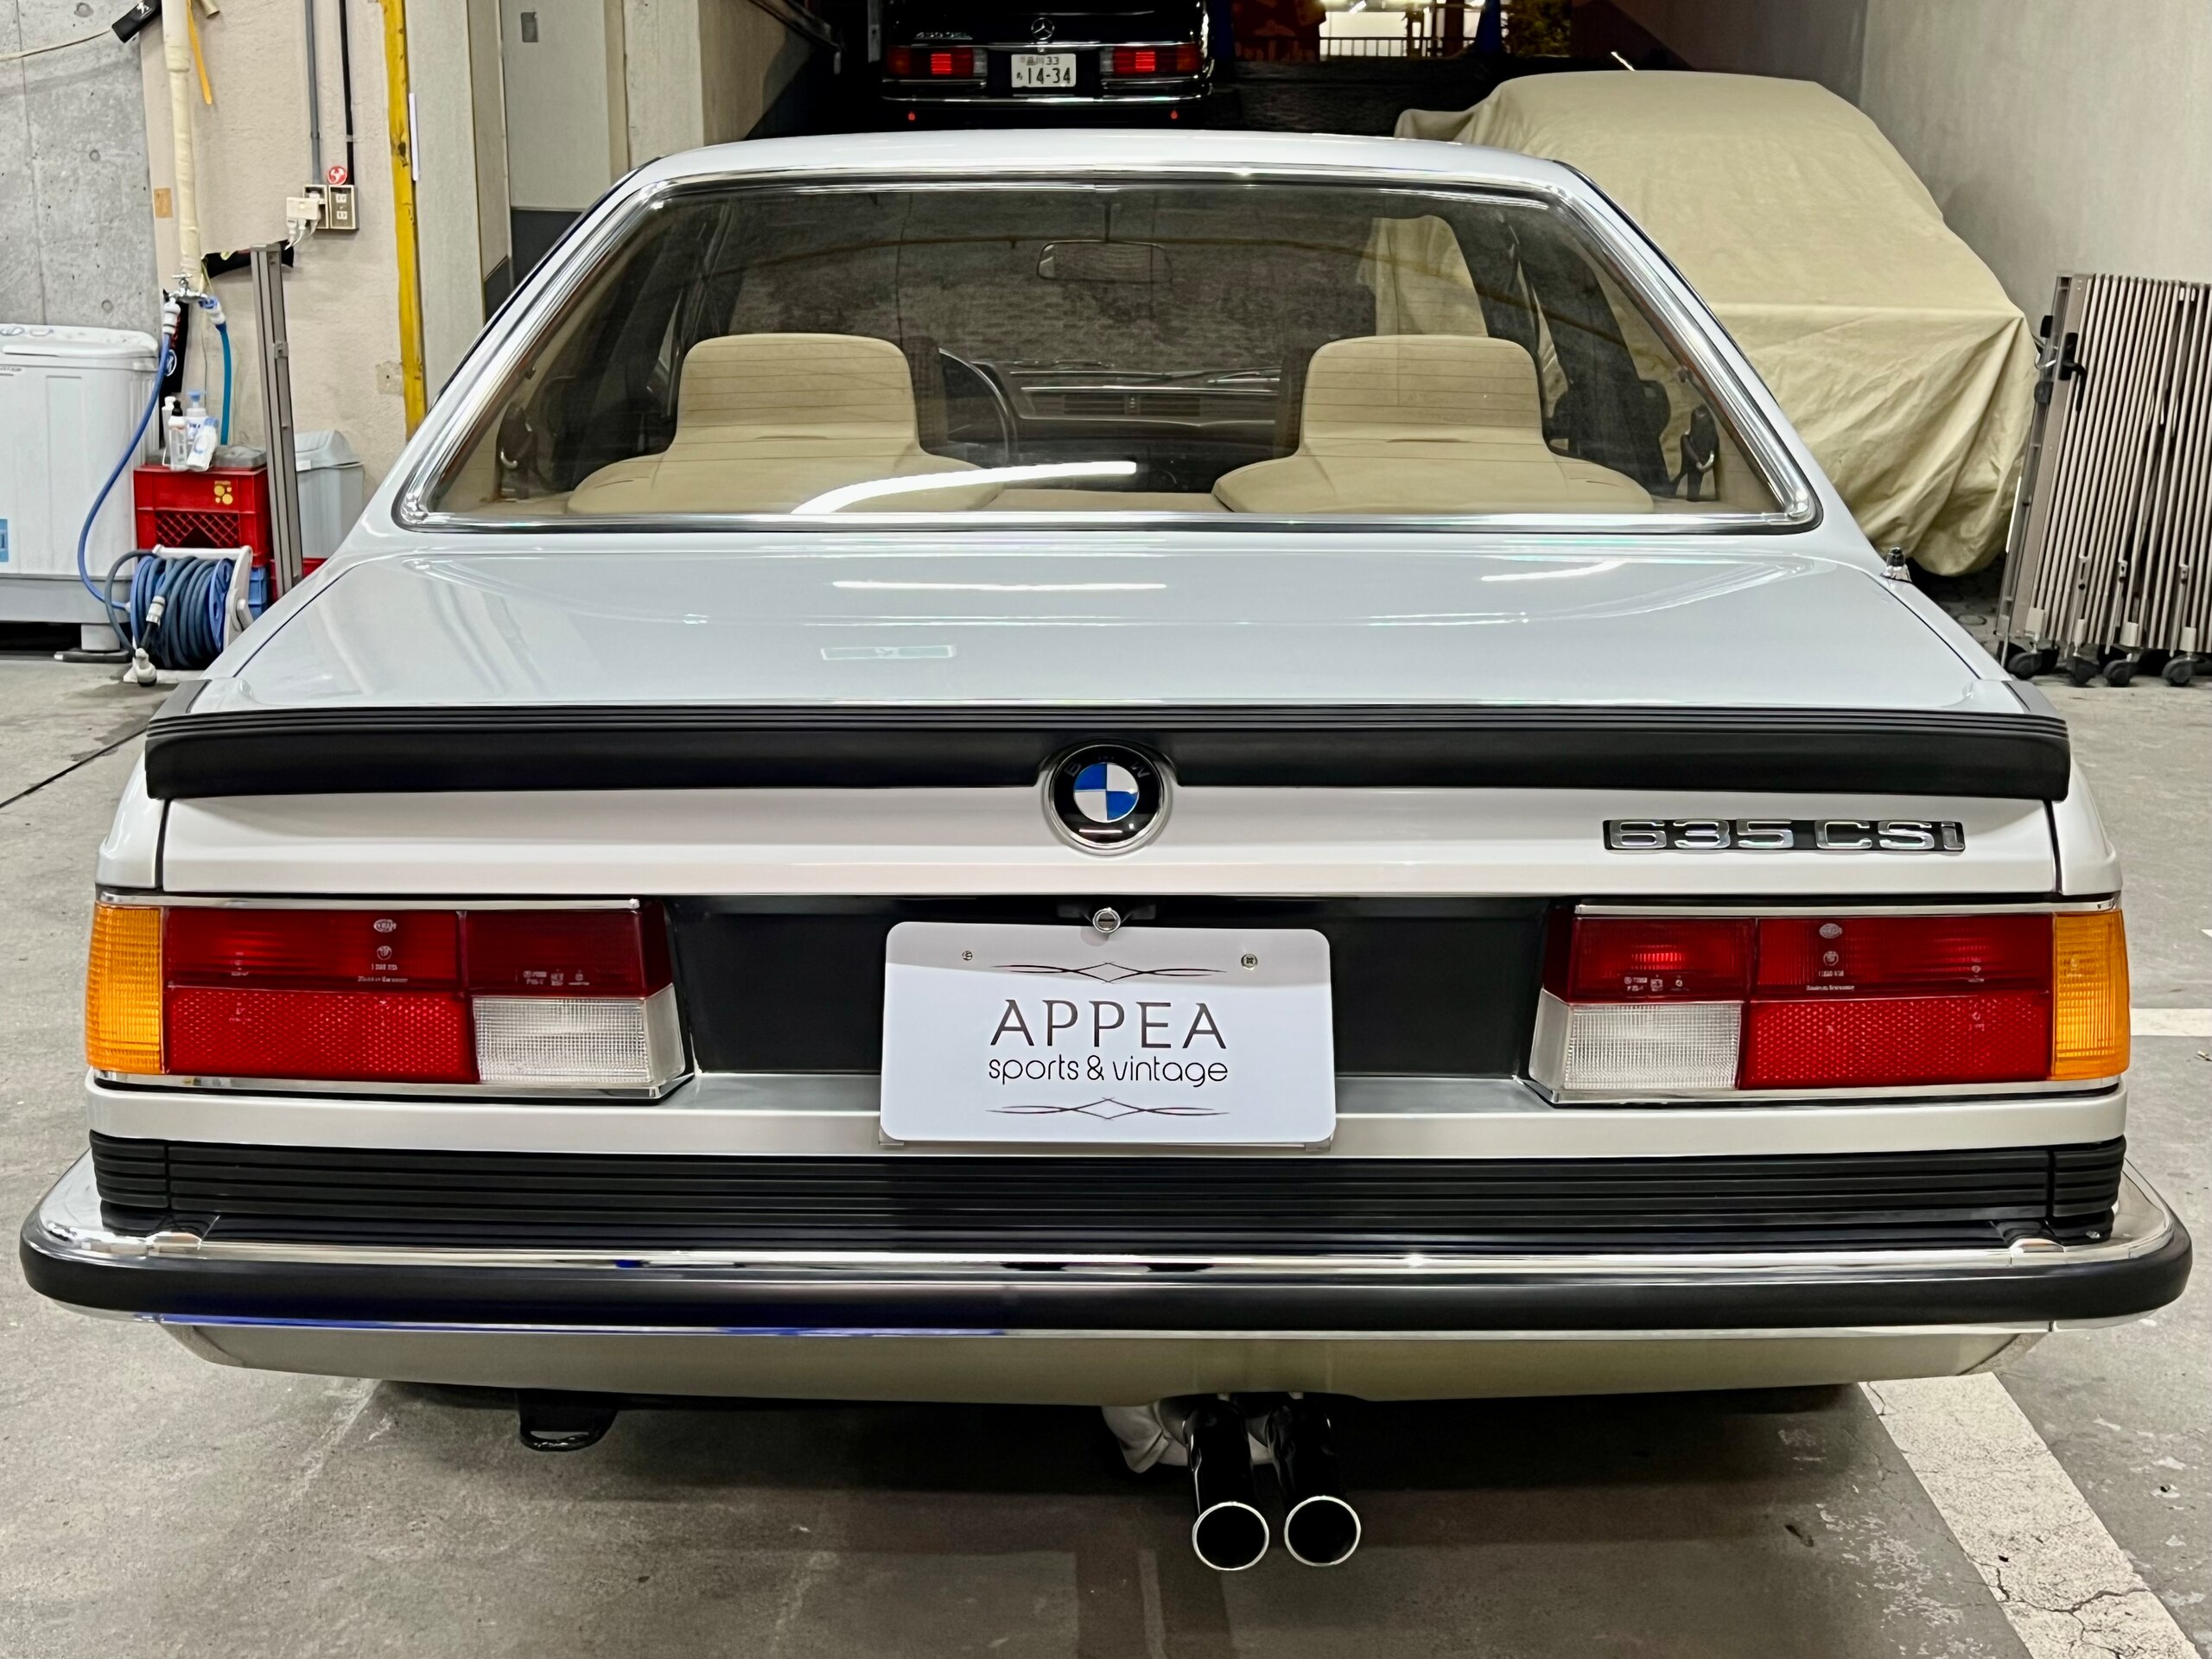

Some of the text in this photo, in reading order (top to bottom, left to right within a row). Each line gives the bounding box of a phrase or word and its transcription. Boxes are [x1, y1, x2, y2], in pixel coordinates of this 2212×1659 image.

[1027, 67, 1071, 85] 14-34
[1046, 56, 1059, 66] 33
[1609, 819, 1965, 850] 635 CSi
[990, 999, 1227, 1050] APPEA
[988, 1053, 1228, 1088] sports & vintage
